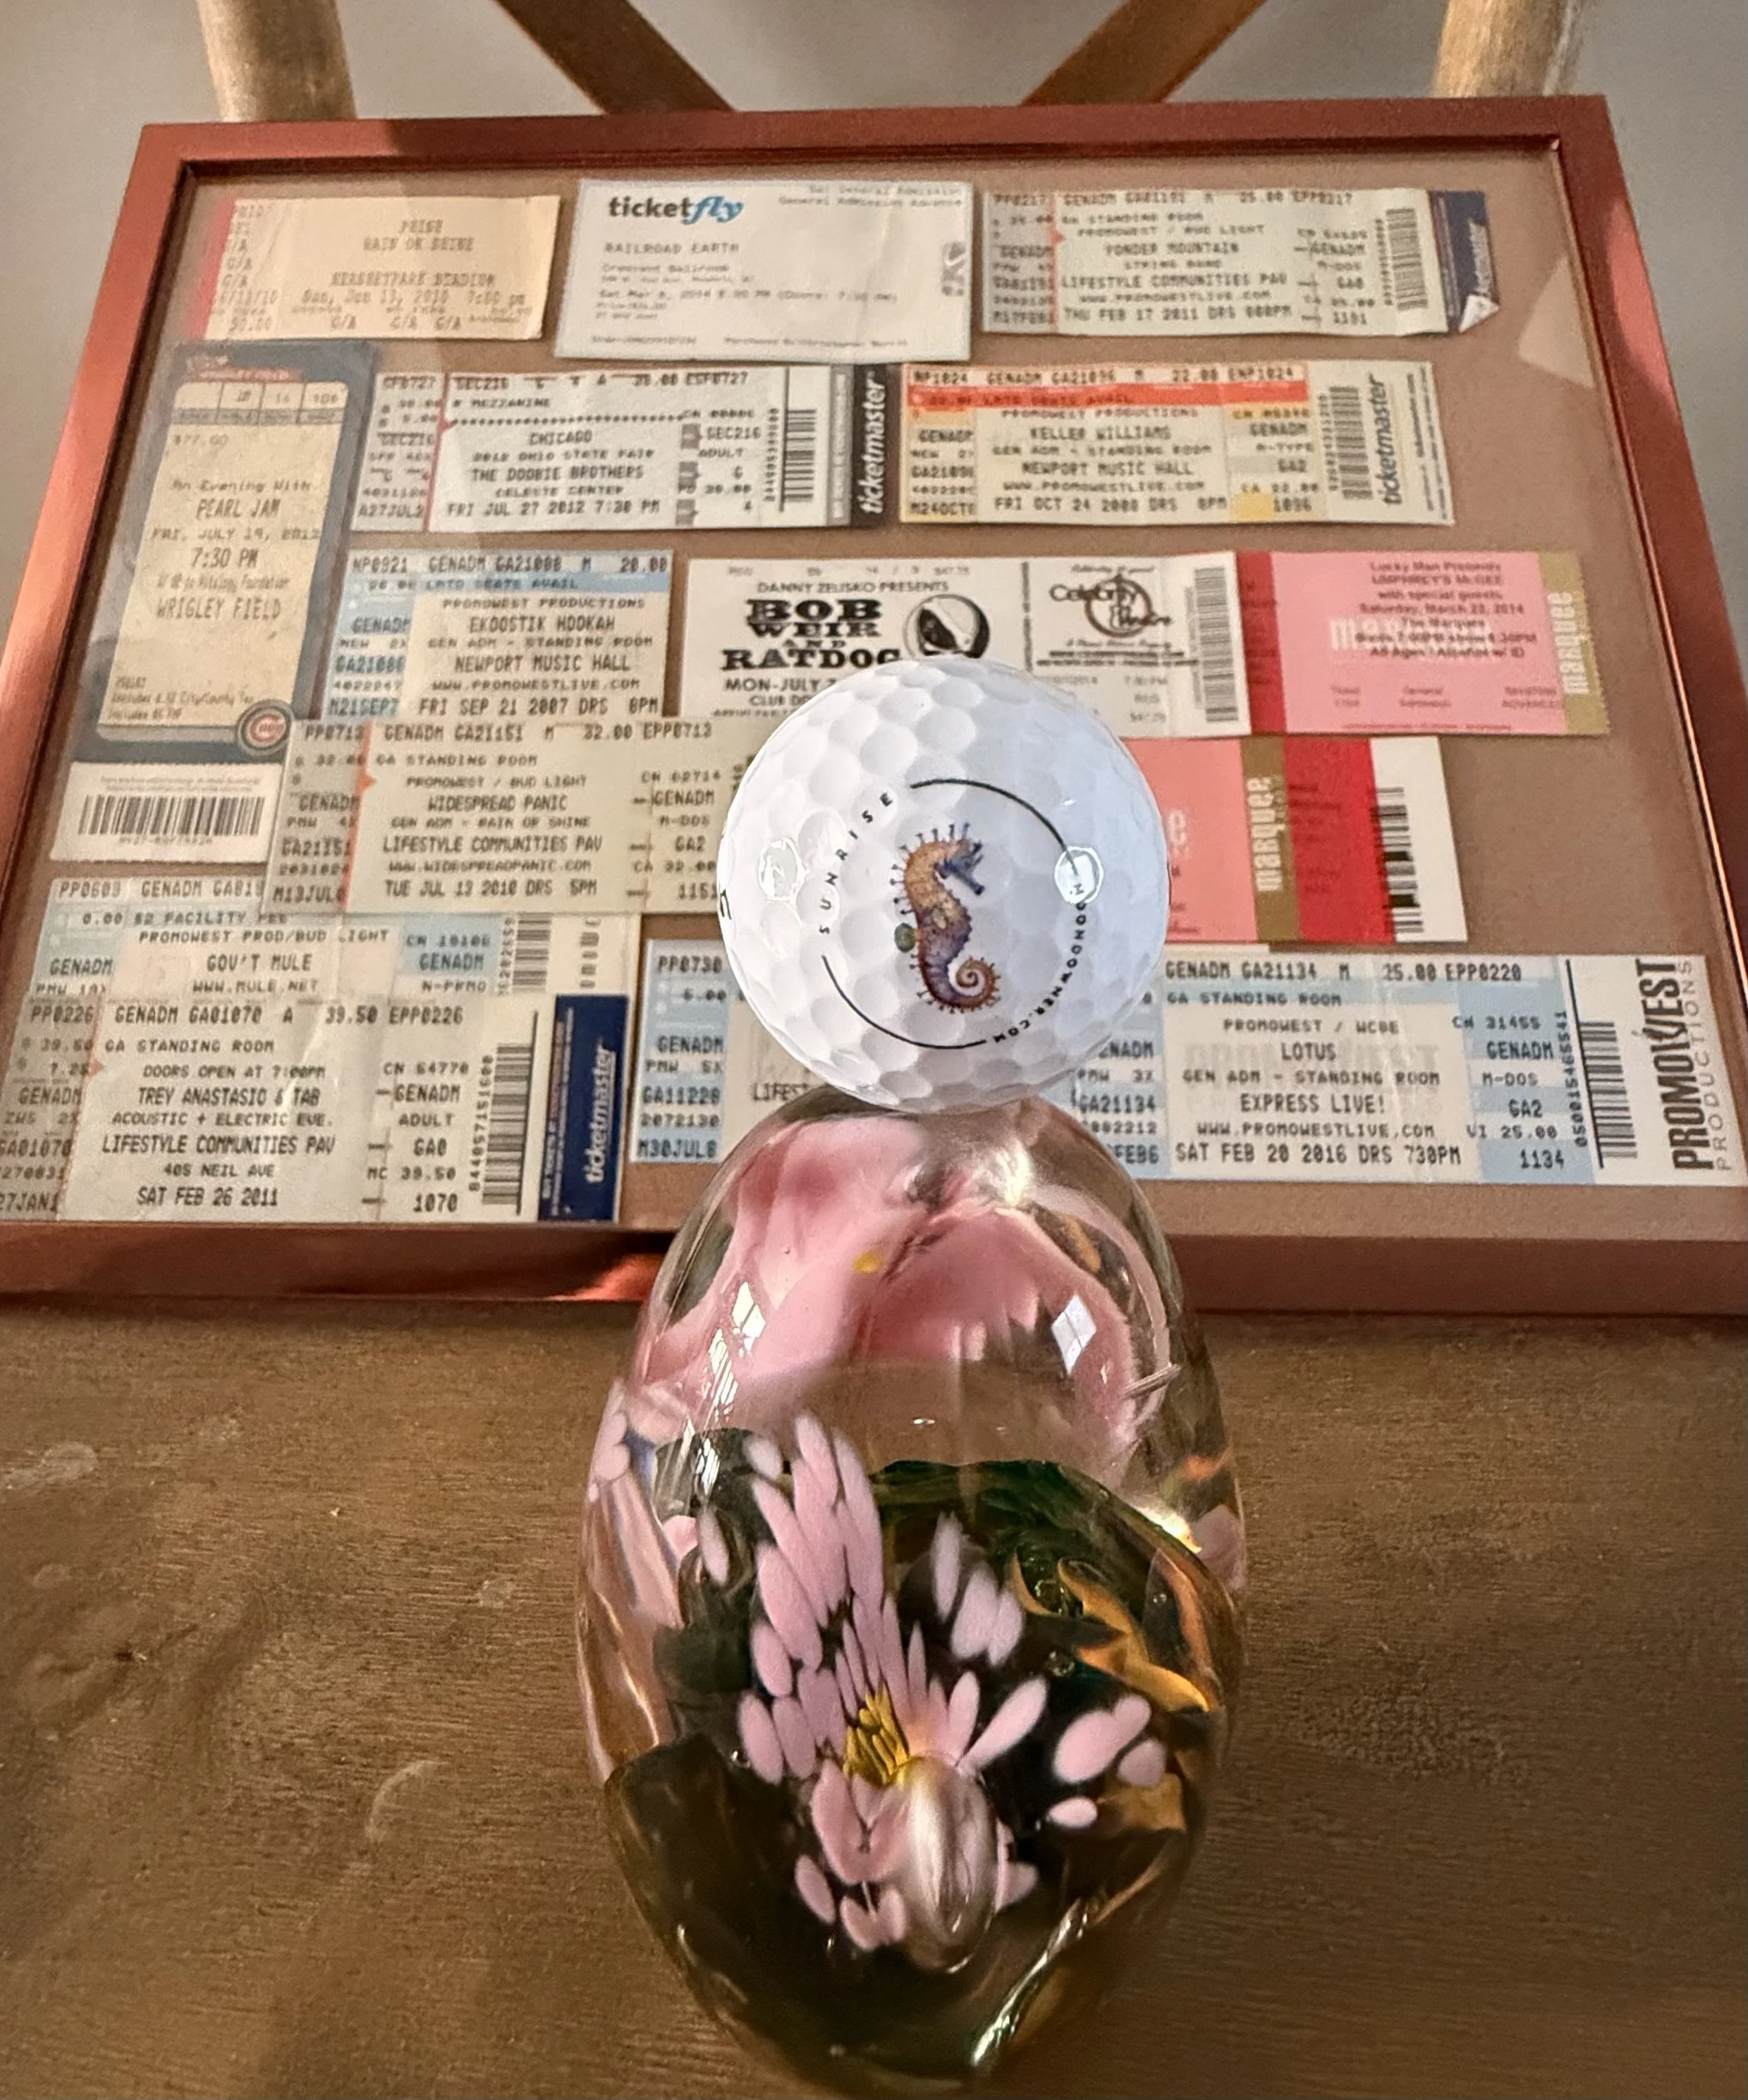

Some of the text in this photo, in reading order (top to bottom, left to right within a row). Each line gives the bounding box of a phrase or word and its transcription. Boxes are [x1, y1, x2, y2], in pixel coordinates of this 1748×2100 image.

[609, 195, 743, 225] ticketfly
[604, 242, 739, 254] RAILROAD EARTH
[1167, 242, 1239, 254] MOUNTAIN
[529, 431, 592, 445] CHICAGO
[1030, 427, 1171, 440] KELLER WILLIAMS
[1369, 372, 1403, 505] ticketmaster
[860, 380, 886, 515] ticketmaster
[472, 466, 644, 481] THE DOOBIE BROTHERS
[1022, 462, 1192, 475] NEWPORT MUSIC HALL
[195, 498, 281, 518] PEARL JAM
[448, 505, 474, 516] FRI
[485, 502, 510, 515] JUL
[521, 502, 539, 515] 27
[549, 501, 585, 513] 2012
[641, 498, 660, 512] PM
[994, 498, 1022, 511] FRI
[1034, 498, 1062, 511] OCT
[1072, 498, 1090, 511] 24
[191, 547, 258, 567] 7:30 PM
[429, 555, 668, 572] GENADM 20.00
[756, 582, 812, 594] DANNY
[879, 581, 950, 592] PRESENTS
[157, 598, 281, 619] WRIGLEY FIELD
[443, 598, 644, 609] PROMOWEST PRODUCTIONS
[745, 598, 882, 621] BOB
[470, 615, 615, 632] EKOOSTIK HOOKAH
[746, 621, 882, 638] WEIR
[428, 636, 652, 648] GEN ADM STANDING ROOM
[782, 639, 847, 648] AND
[454, 654, 631, 672] NEWPORT MUSIC HALL
[720, 648, 901, 670] RATDOG
[726, 677, 826, 692] MON-JULY
[419, 697, 659, 716] FRI SEP 21 2007 DRS 8PM
[384, 724, 444, 741] GENADM
[405, 754, 487, 766] STANDING
[428, 794, 568, 811] WIDESPREAD PANIC
[654, 790, 715, 806] GENADM
[383, 835, 602, 853] LIFESTYLE COMMUNITIES PAV
[818, 792, 893, 935] SUNRISE
[141, 880, 202, 898] GENADM
[385, 879, 411, 897] TUE
[420, 879, 445, 897] JUL
[482, 880, 518, 897] 2010
[525, 878, 553, 896] DRS
[570, 878, 597, 895] 5PM
[49, 958, 114, 975] GENADM
[207, 953, 312, 972] GOV'T MULE
[419, 953, 484, 971] GENADM
[1166, 959, 1522, 981] GENADM GA21134 25.00 EPP0220
[1199, 992, 1341, 1005] STANDING ROOM
[30, 1005, 464, 1025] PP0226 GENADM GA01070 A 39.50 EPP0226
[1223, 1019, 1321, 1032] PROMOWEST
[137, 1039, 274, 1052] STANDING ROOM
[658, 1036, 723, 1053] GENADM
[1281, 1041, 1336, 1061] LOTUS
[1486, 1042, 1554, 1060] GENADM
[143, 1064, 262, 1078] DOORS OPEN AT
[1634, 958, 1714, 1171] PROMOWEST
[1677, 961, 1732, 1172] PRODUCTIONS
[1182, 1072, 1440, 1085] GEN ADM STANDING ROOM
[137, 1086, 320, 1106] TREY ANASTASIO TAB
[394, 1085, 460, 1102] GENADM
[582, 1038, 616, 1184] ticketmaster
[1240, 1093, 1386, 1114] EXPRESS LIVE!
[1508, 1098, 1543, 1119] GA2
[111, 1112, 288, 1126] ACOUSTIC ELECTRIC
[399, 1113, 455, 1126] ADULT
[102, 1134, 336, 1154] LIFESTYLE COMMUNITIES PAV
[1175, 1142, 1461, 1165] SAT FEB 20 2016 DRS 730PM
[1520, 1149, 1565, 1169] 1134
[200, 1163, 238, 1177] NEIL
[248, 1163, 276, 1176] AVE
[137, 1186, 278, 1206] SAT FEB 26 2011
[413, 1193, 458, 1212] 1070
